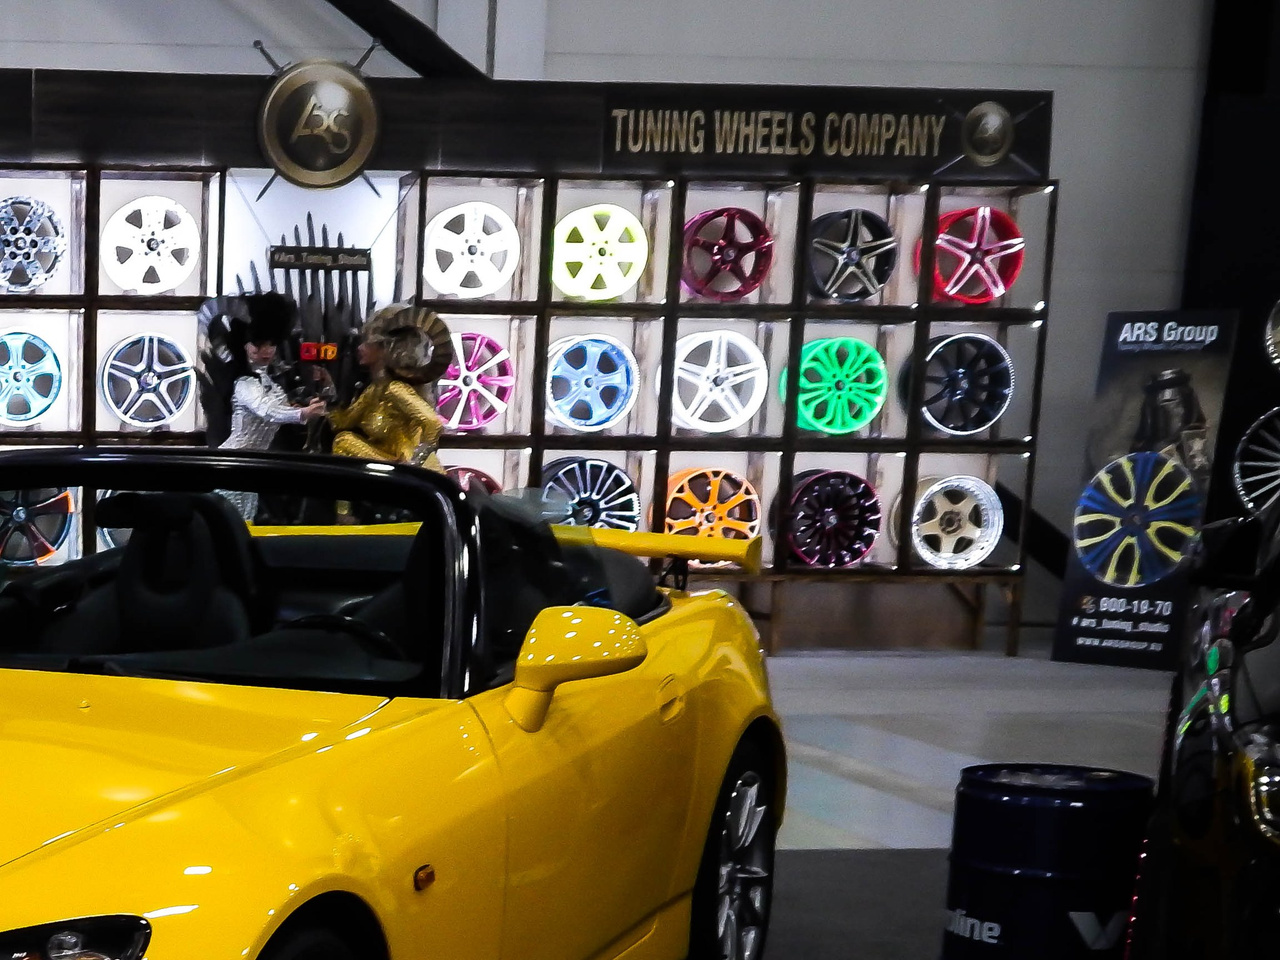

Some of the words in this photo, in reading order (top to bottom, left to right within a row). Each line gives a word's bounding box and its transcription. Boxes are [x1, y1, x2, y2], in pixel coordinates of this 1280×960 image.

[611, 108, 705, 154] TUNING
[714, 110, 816, 156] WHEELS
[824, 112, 947, 157] COMPANY
[1119, 321, 1159, 342] ARS
[1163, 321, 1219, 346] Group
